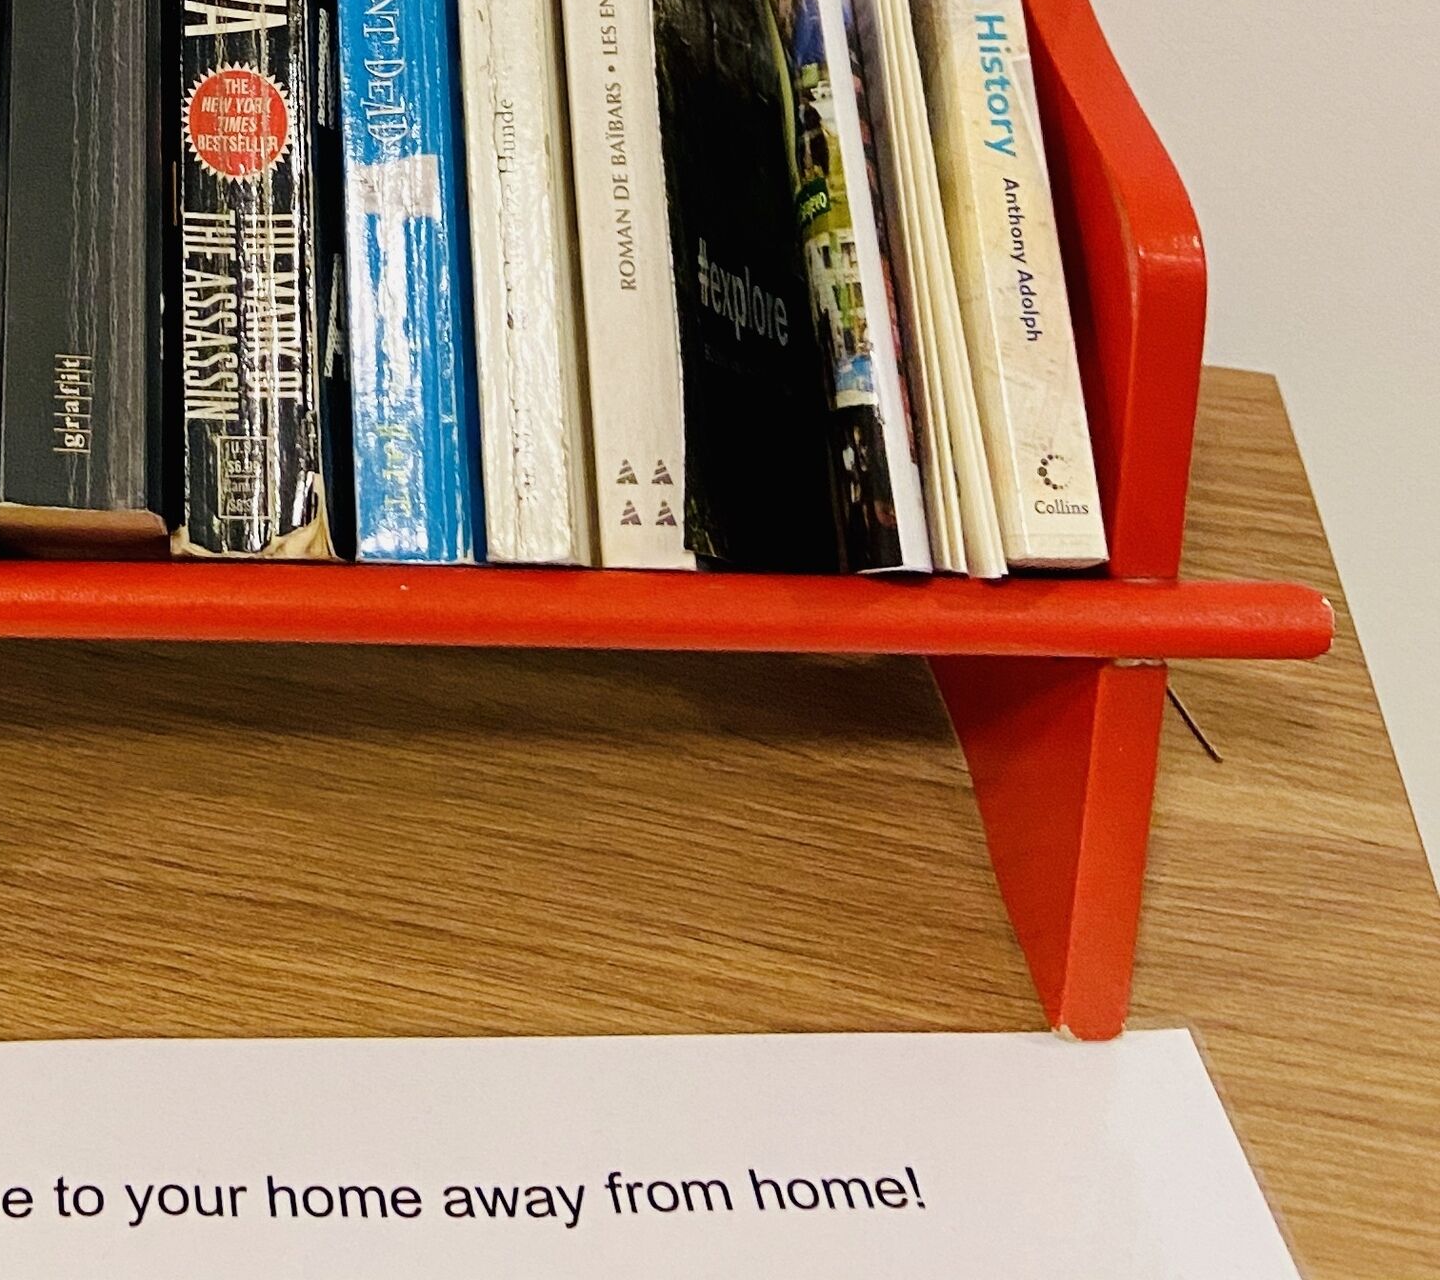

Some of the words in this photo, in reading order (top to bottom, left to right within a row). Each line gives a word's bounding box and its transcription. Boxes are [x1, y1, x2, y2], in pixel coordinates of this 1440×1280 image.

[601, 24, 619, 57] LES
[201, 95, 233, 113] NEW
[236, 96, 273, 114] YORK
[223, 78, 249, 95] THE
[359, 56, 412, 147] DEAD
[197, 133, 279, 153] BESTSELLER
[217, 115, 258, 133] TIMES
[605, 81, 627, 168] BAÏBARS
[613, 173, 631, 202] DE
[974, 14, 1017, 158] History
[1002, 177, 1028, 264] Anthony
[1017, 268, 1043, 342] Adolph
[183, 210, 237, 262] THE
[618, 208, 638, 291] ROMAN
[697, 236, 790, 348] #explore
[183, 268, 240, 422] ASSASSIN
[59, 356, 85, 449] grafit
[1033, 499, 1090, 516] Collins
[53, 1176, 106, 1218] to
[124, 1183, 248, 1228] your
[267, 1175, 422, 1219] home
[442, 1183, 585, 1229] away
[604, 1171, 734, 1215] from
[747, 1166, 927, 1212] home!
